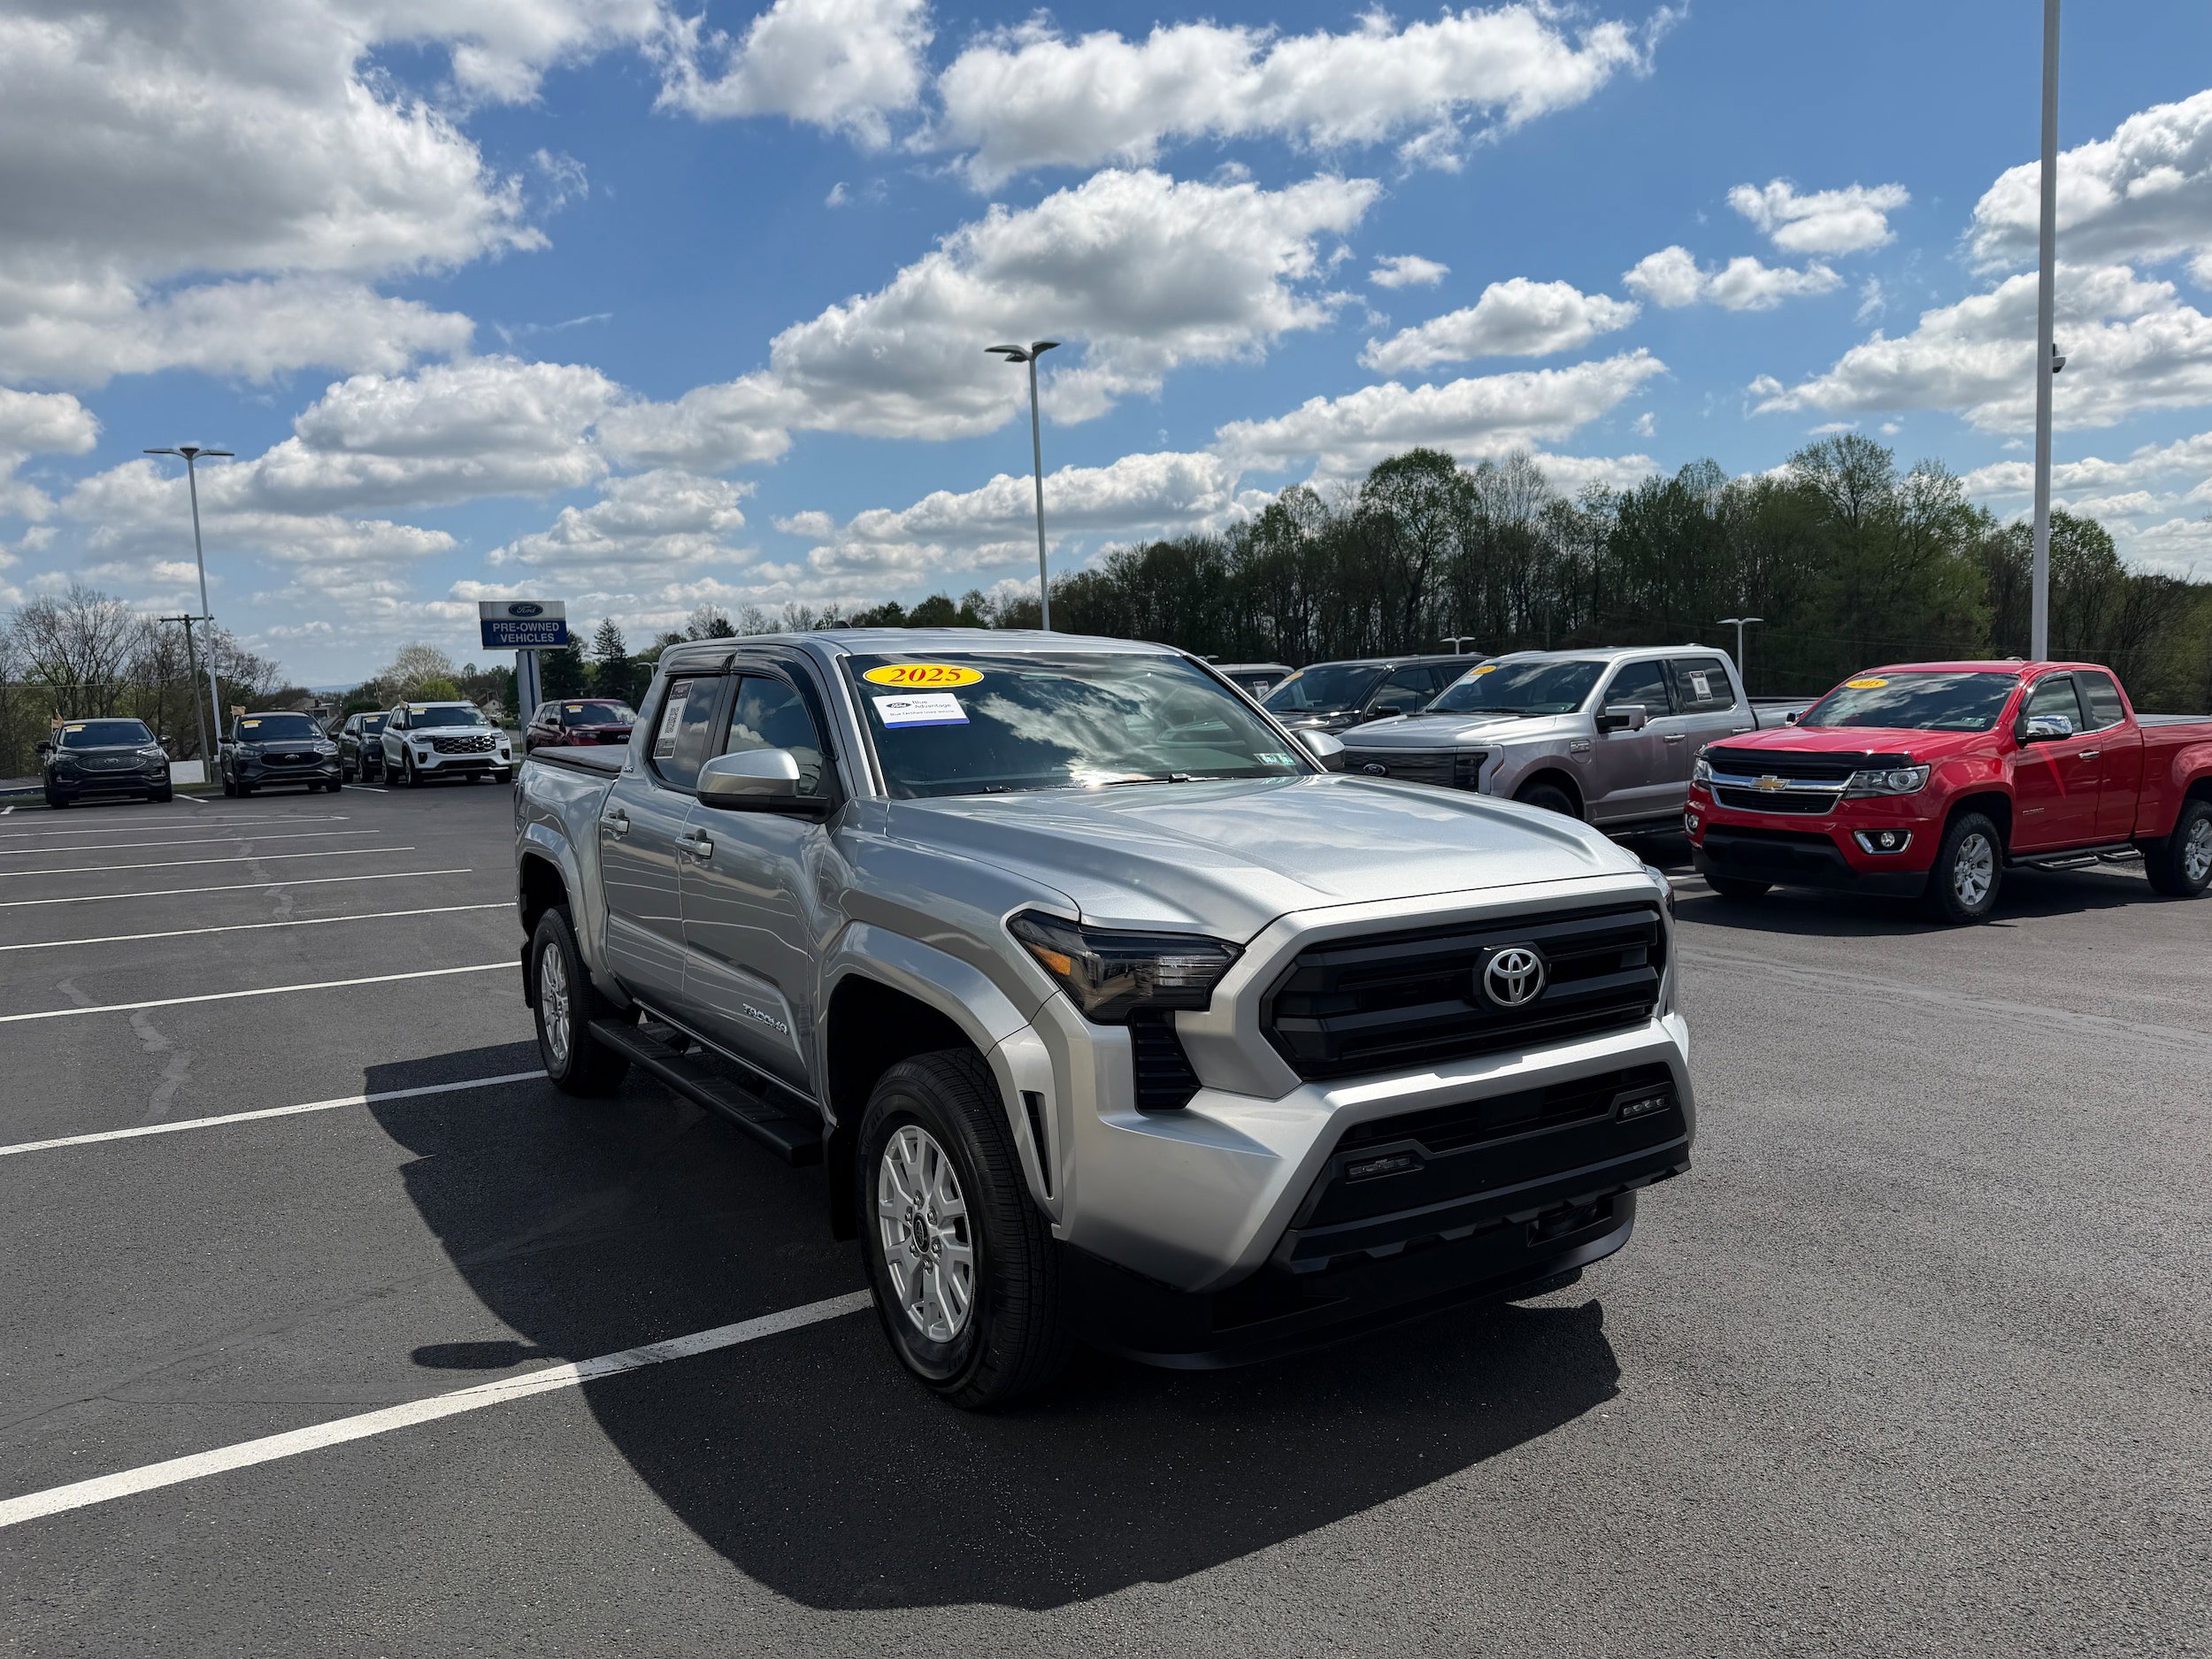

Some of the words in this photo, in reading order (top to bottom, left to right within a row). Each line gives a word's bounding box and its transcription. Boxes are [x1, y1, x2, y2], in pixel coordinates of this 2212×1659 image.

[517, 605, 536, 614] Ford
[493, 622, 560, 633] PRE-OWNED
[500, 633, 555, 643] VEHICLES
[889, 668, 963, 682] 2025
[742, 1002, 787, 1035] TACOMA
